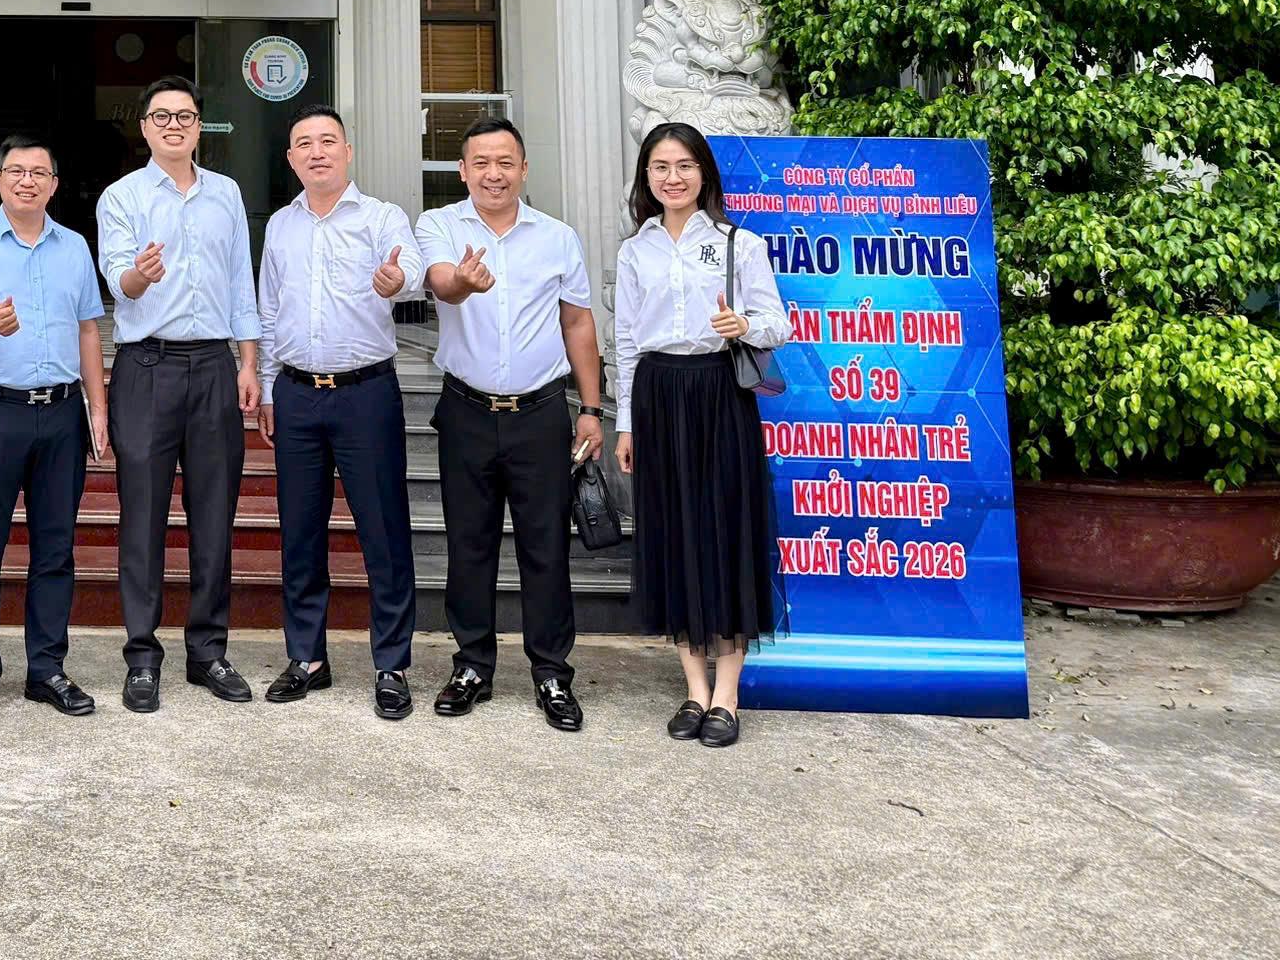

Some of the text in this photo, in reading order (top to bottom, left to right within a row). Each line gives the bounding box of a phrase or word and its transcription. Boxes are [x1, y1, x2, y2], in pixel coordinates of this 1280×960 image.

[784, 163, 914, 186] CÔNG TY CỔ PHẦN
[725, 193, 977, 217] THƯƠNG MẠI VÀ DỊCH VỤ BÌNH LIÊU
[765, 226, 969, 277] HÀO MỪNG
[827, 297, 896, 344] THẨM
[902, 311, 963, 351] ĐỊNH
[830, 355, 900, 401] SỐ 39
[763, 414, 970, 461] DOANH NHÂN TRẺ
[793, 470, 949, 526] KHỞI NGHIỆP
[777, 528, 966, 578] XUẤT SẮC 2026
